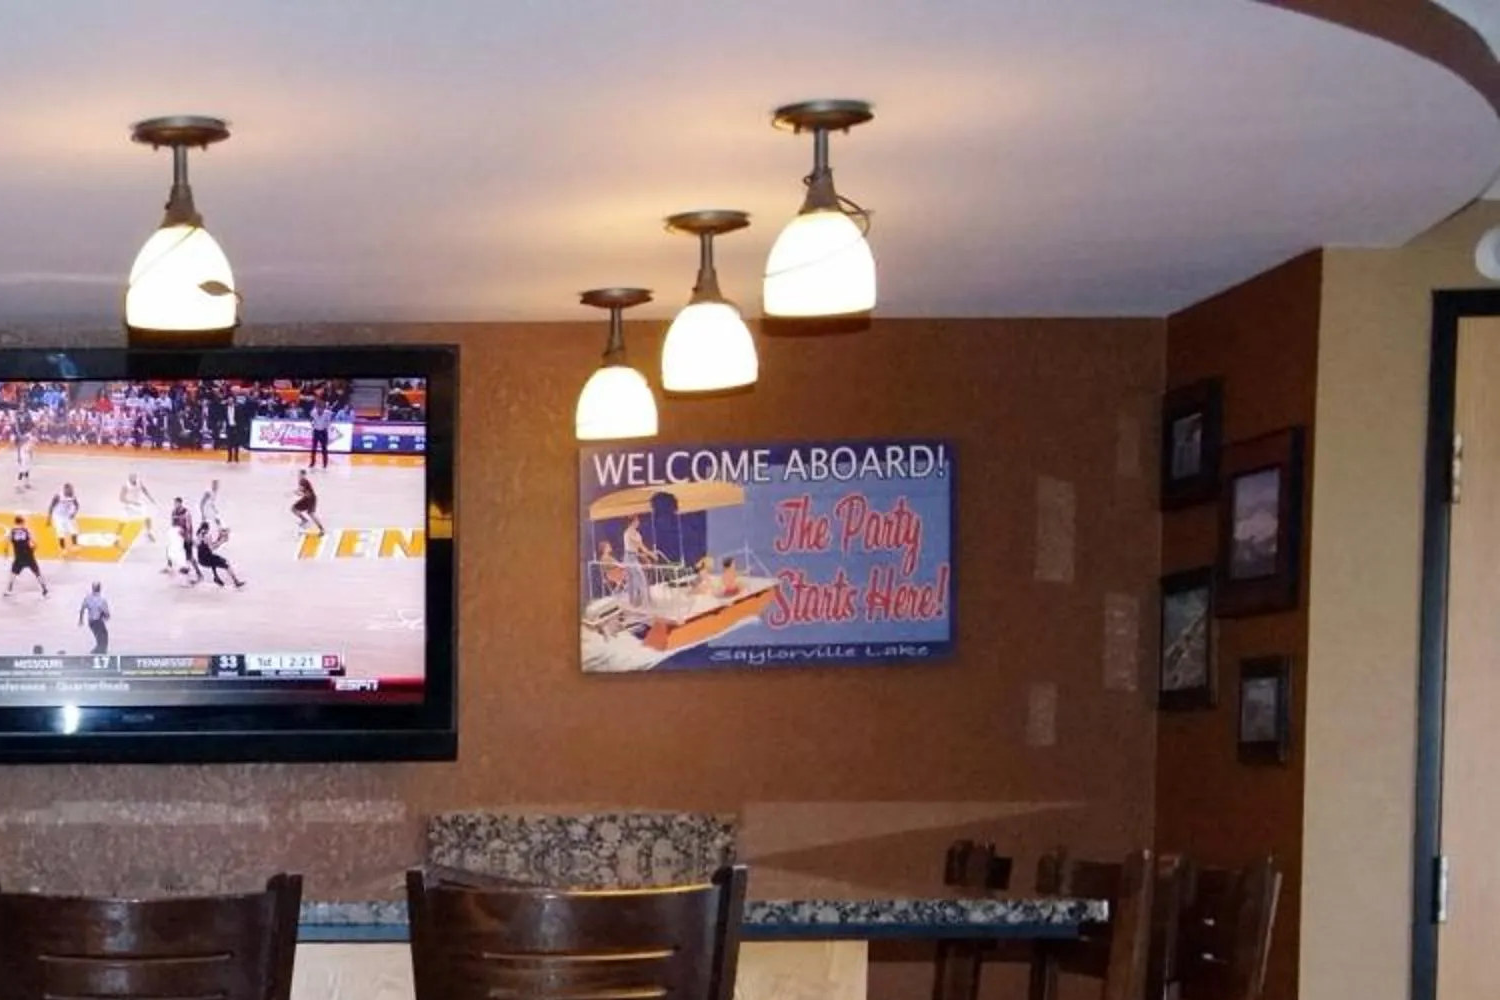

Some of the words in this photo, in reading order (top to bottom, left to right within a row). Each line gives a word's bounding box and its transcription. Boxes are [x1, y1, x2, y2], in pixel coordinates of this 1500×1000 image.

[594, 449, 771, 486] WELCOME
[783, 444, 946, 481] ABOARD!
[773, 495, 831, 553] The
[835, 492, 921, 573] Party
[767, 567, 858, 631] Starts
[865, 563, 950, 623] Here!
[92, 656, 110, 669] 17
[865, 644, 930, 657] Lake
